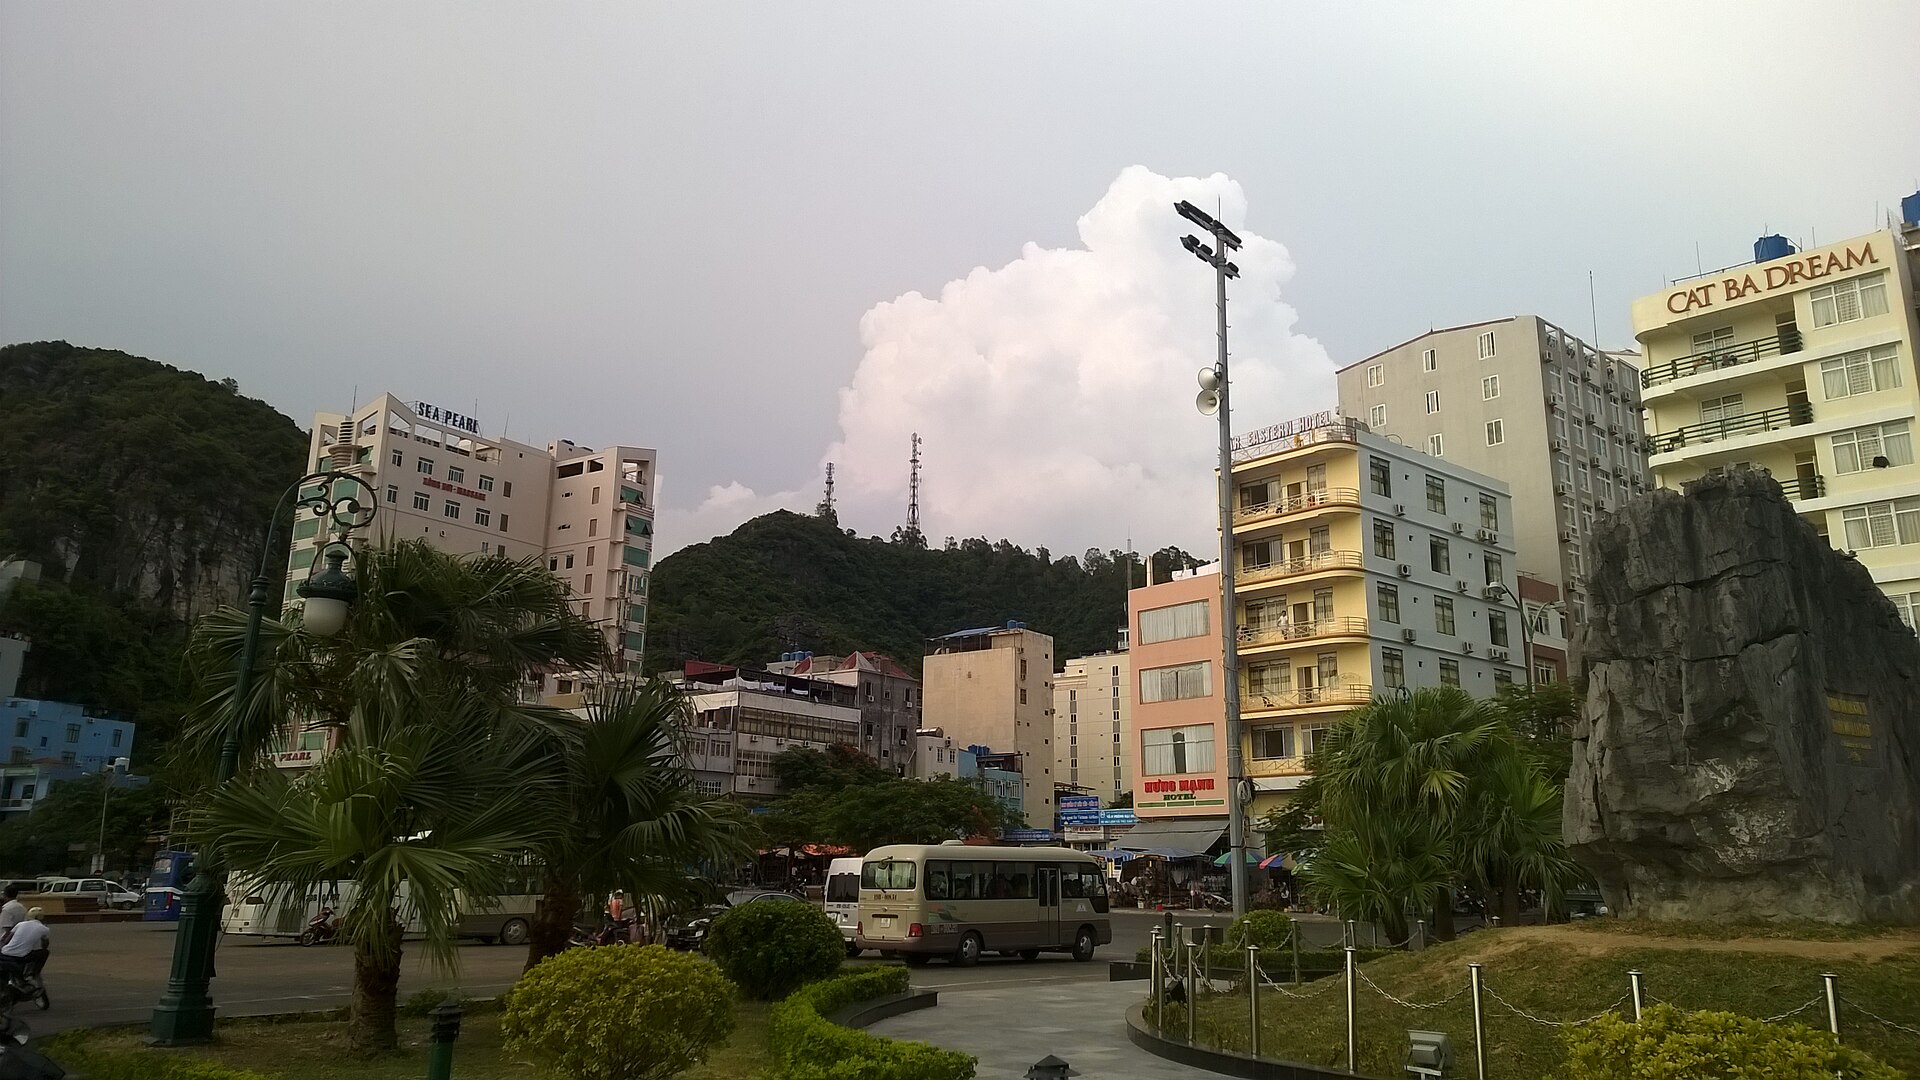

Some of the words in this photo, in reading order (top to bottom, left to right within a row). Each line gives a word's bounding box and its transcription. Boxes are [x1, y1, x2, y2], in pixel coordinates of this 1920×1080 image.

[1666, 283, 1716, 314] CAT
[1722, 274, 1762, 301] BA
[1764, 241, 1879, 291] DREAM
[418, 401, 440, 421] SEA
[444, 410, 478, 434] PEARL
[1247, 420, 1293, 447] EASTERN
[1298, 410, 1331, 433] HOTEL
[280, 751, 312, 762] PEARL
